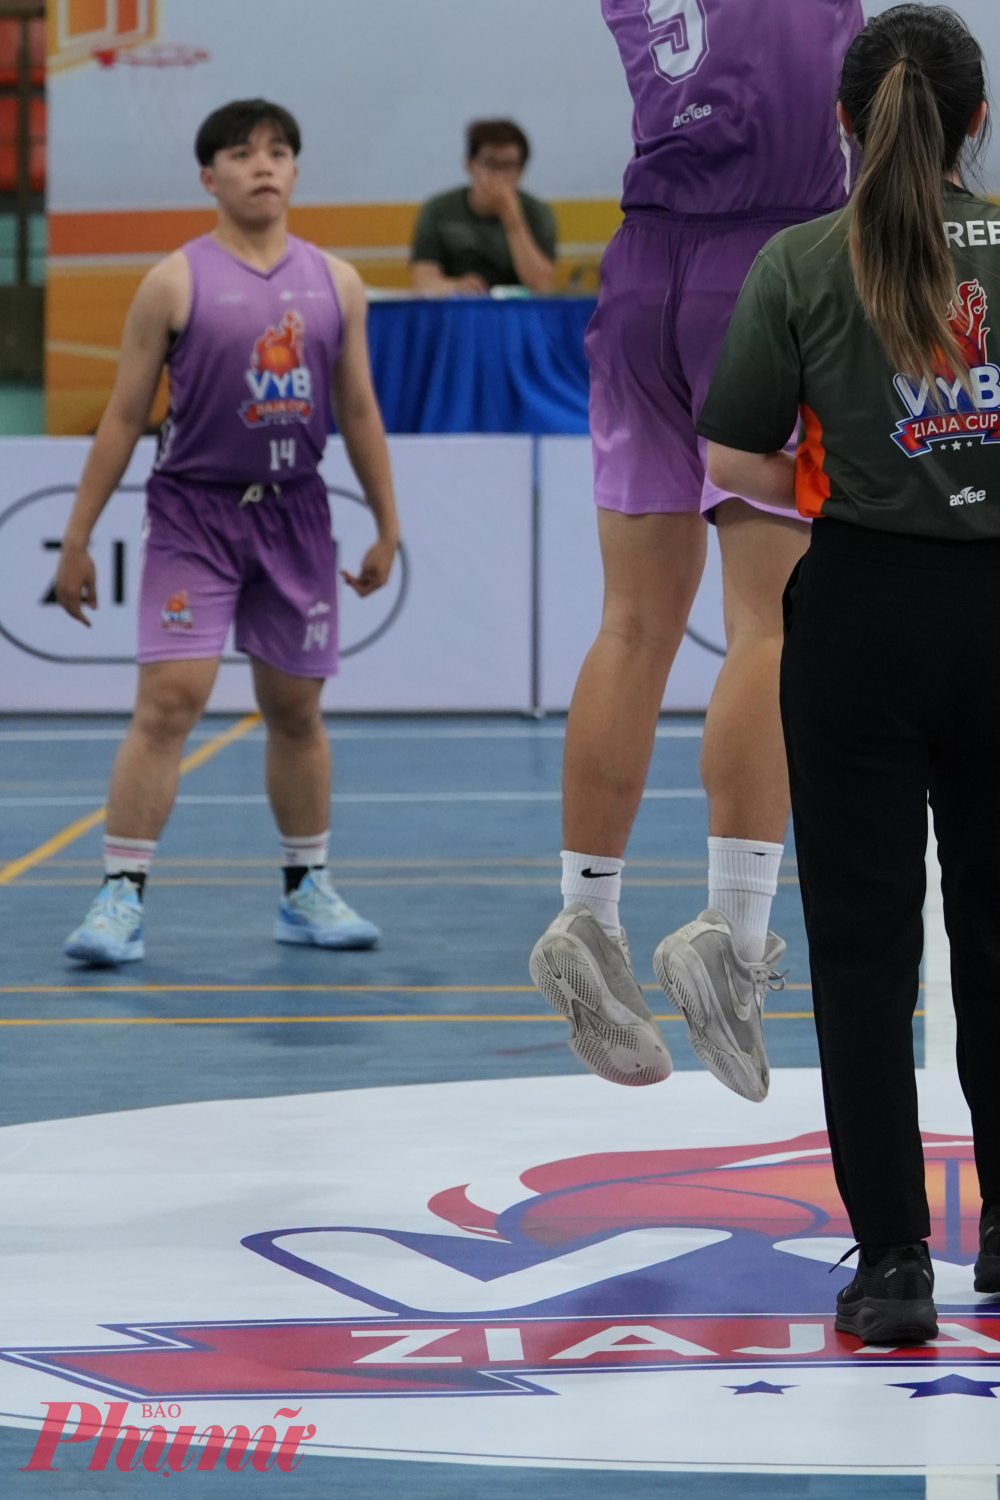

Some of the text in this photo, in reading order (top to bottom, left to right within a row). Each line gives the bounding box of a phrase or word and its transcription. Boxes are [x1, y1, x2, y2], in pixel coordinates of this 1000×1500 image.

[245, 366, 312, 401] VYB
[911, 413, 999, 440] ZIAJA CUP
[269, 437, 297, 472] 14
[302, 621, 329, 652] 14
